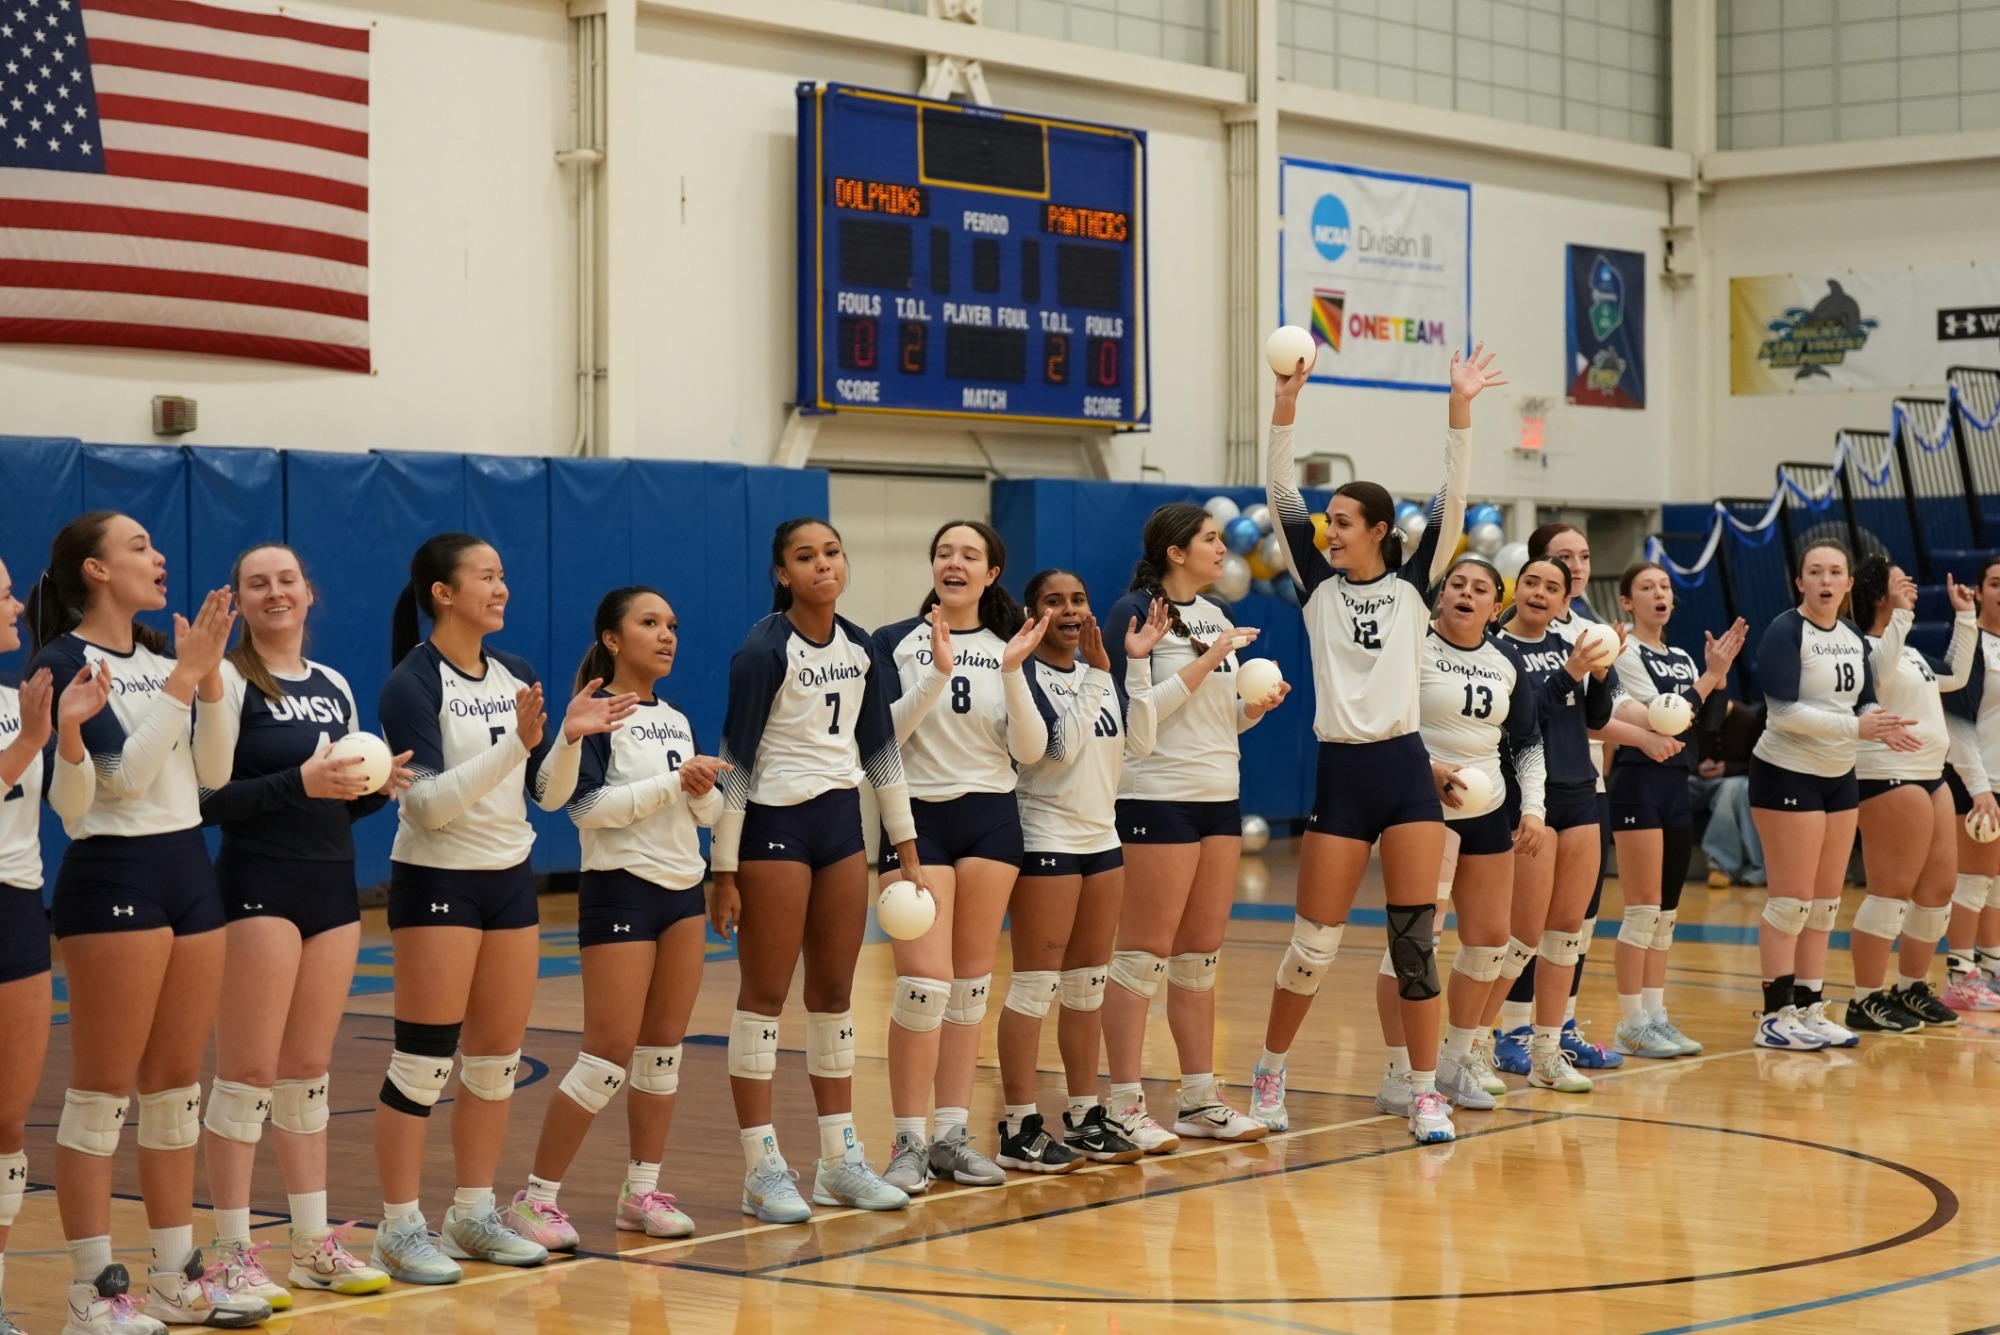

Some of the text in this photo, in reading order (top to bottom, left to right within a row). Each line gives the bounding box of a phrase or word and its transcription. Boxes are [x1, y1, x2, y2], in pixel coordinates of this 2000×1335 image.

[835, 178, 921, 216] DOLPHINS
[963, 211, 1010, 236] PERIOD
[1048, 205, 1128, 242] PANTHERS
[1358, 225, 1418, 258] Division
[837, 292, 882, 317] FOULS
[895, 297, 932, 321] T.O.L.
[943, 302, 1030, 330] PLAYER FOUL
[1040, 311, 1074, 334] T.O.L.
[1085, 314, 1124, 338] FOULS
[1349, 312, 1446, 346] ONETEAM
[854, 319, 875, 367] 0
[904, 324, 924, 372] 2
[1048, 336, 1066, 382] 2
[1099, 340, 1118, 386] 0
[836, 378, 881, 403] SCORE
[962, 387, 1007, 410] MATCH
[1083, 395, 1122, 419] SCORE
[1353, 617, 1382, 650] 12
[1834, 662, 1856, 693] 18
[264, 695, 345, 725] UMSV
[449, 694, 517, 723] Dolphin
[951, 676, 971, 715] 8
[1461, 683, 1493, 720] 13
[825, 692, 841, 736] 7
[630, 721, 692, 746] Dolphins
